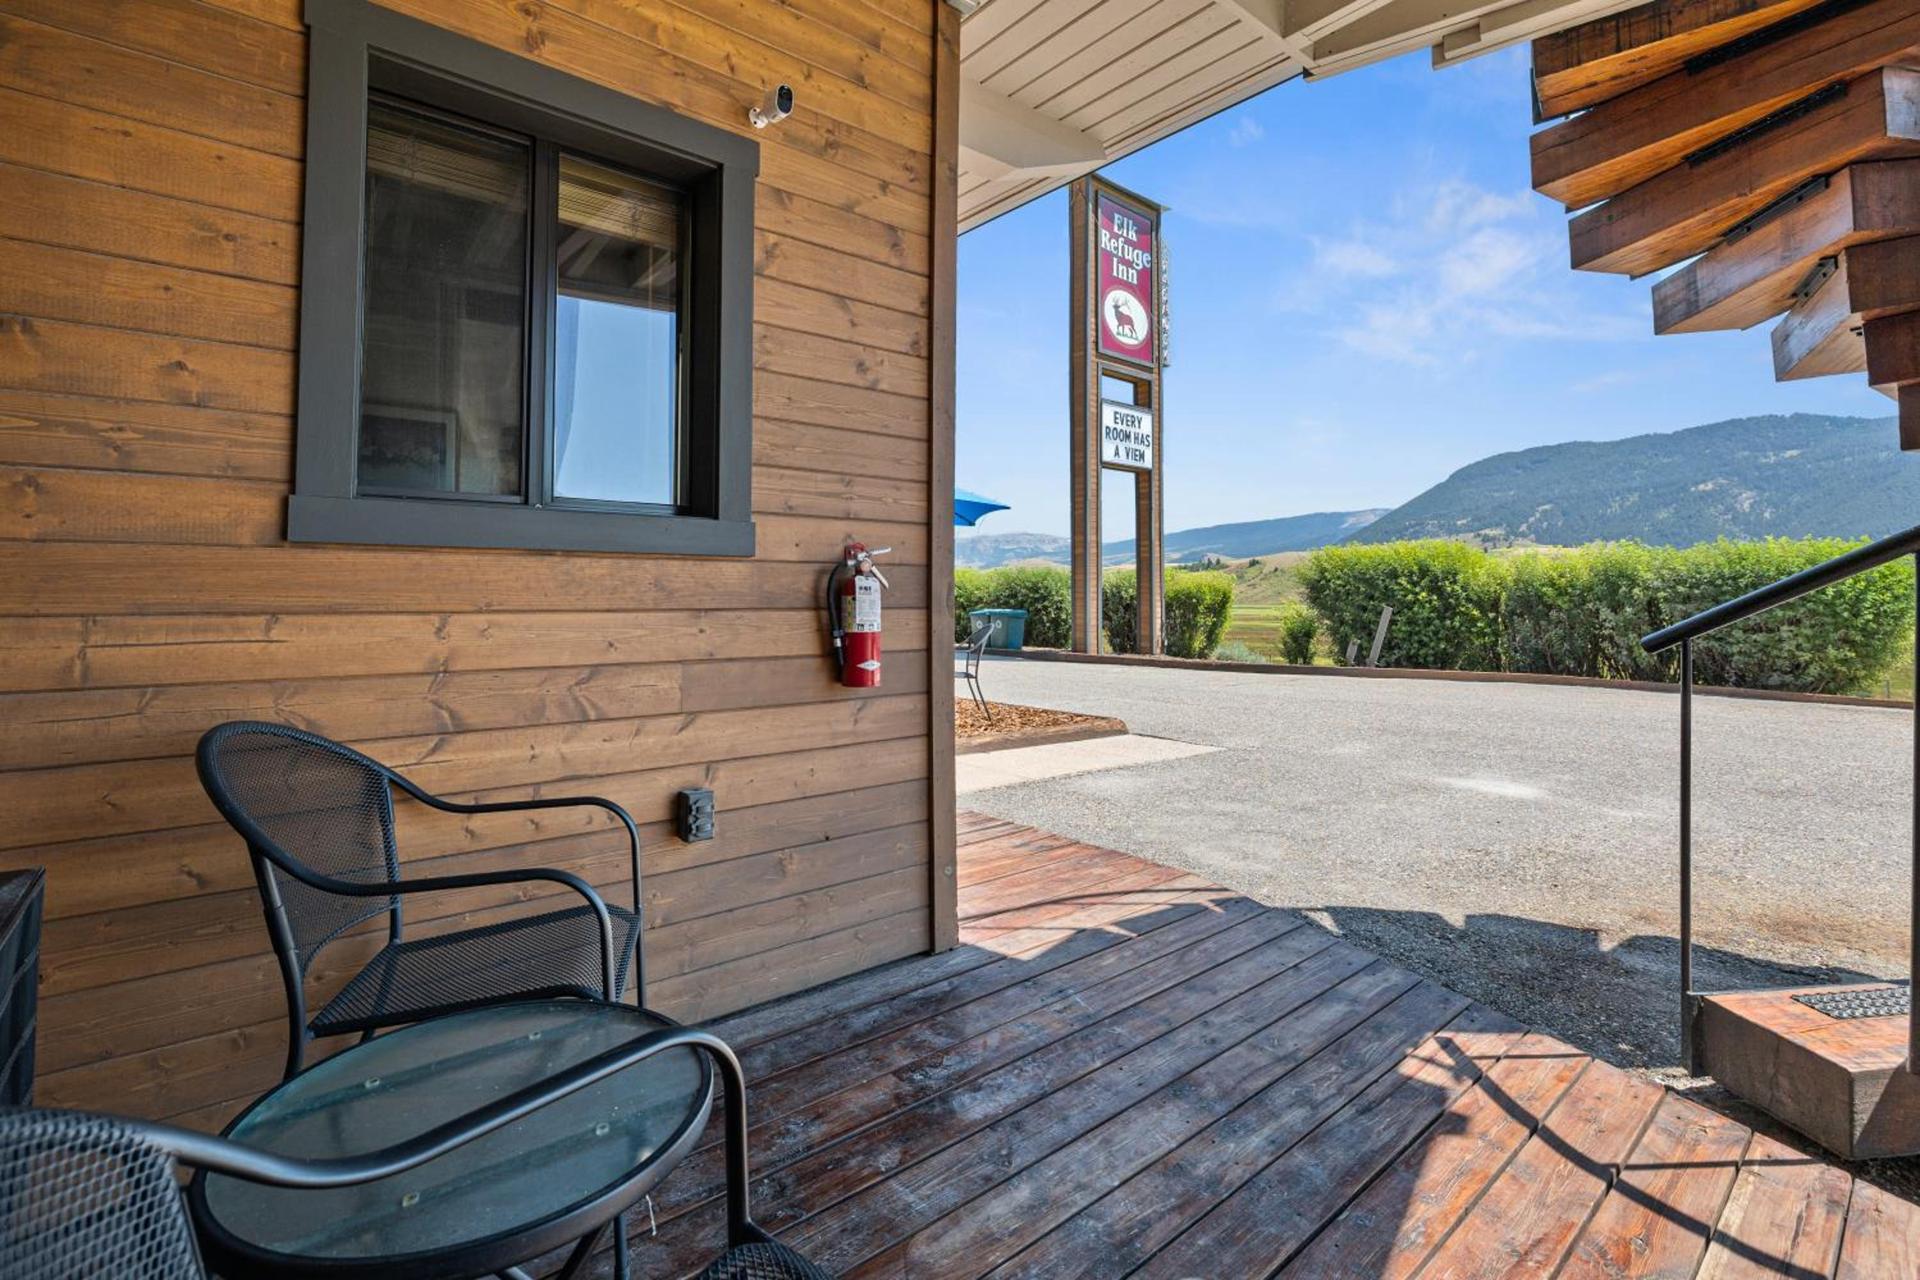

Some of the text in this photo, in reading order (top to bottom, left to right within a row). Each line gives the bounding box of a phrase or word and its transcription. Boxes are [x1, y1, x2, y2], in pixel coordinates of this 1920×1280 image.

[1114, 213, 1137, 242] Elk
[1101, 229, 1151, 270] Refuge
[1112, 258, 1138, 285] Inn
[1114, 411, 1142, 429] EVERY
[1105, 426, 1150, 447] ROOM HAS
[1114, 445, 1120, 458] A
